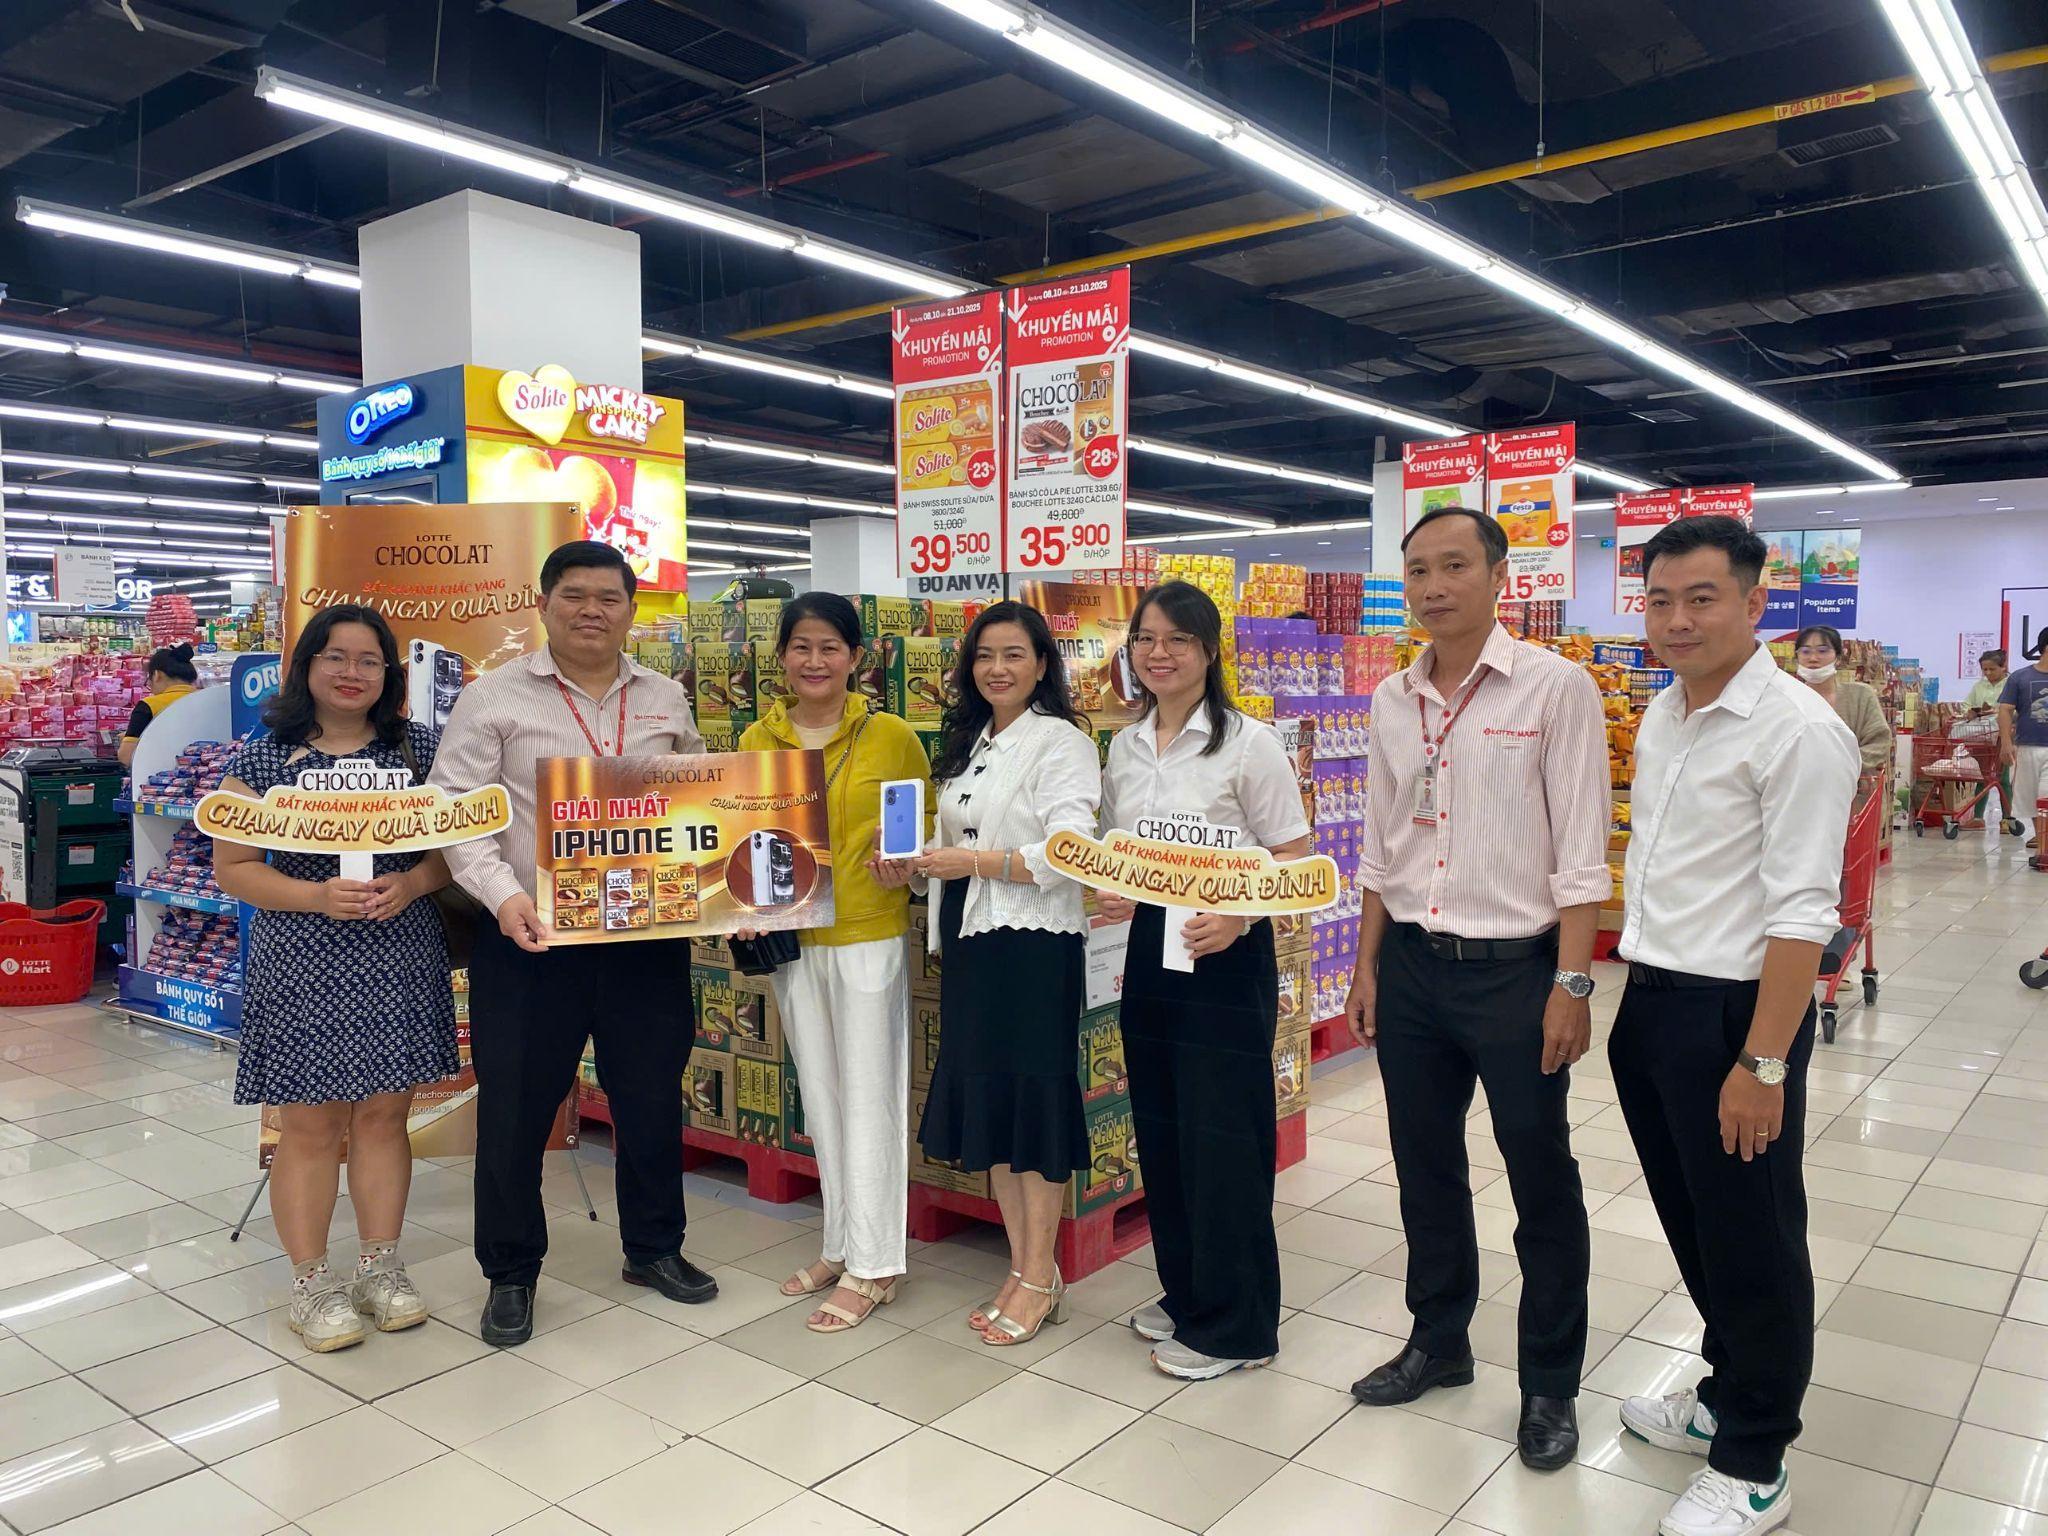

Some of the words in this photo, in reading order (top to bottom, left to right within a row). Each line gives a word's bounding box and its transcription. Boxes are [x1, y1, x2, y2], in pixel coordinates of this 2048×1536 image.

[1777, 106, 1788, 119] LP
[1791, 102, 1807, 116] GAS
[1043, 288, 1062, 299] 08.10
[1070, 280, 1108, 294] 21.10.2025
[923, 310, 940, 321] 08.10
[947, 303, 981, 317] 21.10.2025
[1018, 310, 1083, 338] KHUYẾN
[1086, 303, 1119, 325] MÃI
[901, 329, 961, 358] KHUYẾN
[963, 325, 991, 347] MÃI
[1041, 331, 1094, 348] PROMOTION
[923, 352, 969, 367] PROMOTION
[1052, 371, 1078, 381] LOTTE
[516, 385, 567, 411] Solite
[1021, 378, 1112, 408] CHOCOLAT
[350, 387, 412, 435] OREO
[575, 385, 666, 424] MICKEY
[593, 405, 649, 424] INSPIRED
[915, 408, 952, 432] Solite
[588, 414, 647, 443] CAKE
[1086, 448, 1118, 467] -28%
[1410, 457, 1454, 473] KHUYẾN
[1456, 454, 1476, 467] MÃI
[1495, 447, 1543, 463] KHUYẾN
[1545, 445, 1567, 458] MÃI
[323, 456, 350, 480] Bánh
[351, 455, 372, 478] quy
[915, 454, 952, 477] Solite
[968, 461, 995, 478] -23%
[1512, 460, 1550, 469] PROMOTION
[1426, 470, 1461, 479] PROMOTION
[1009, 490, 1028, 499] BÁNH
[1050, 487, 1059, 496] LA
[1060, 486, 1071, 495] PIE
[1072, 485, 1093, 494] LOTTE
[1044, 497, 1066, 506] LOTTE
[1067, 496, 1084, 505] 324G
[1102, 493, 1119, 504] LOẠI
[904, 501, 920, 509] BÁNH
[921, 499, 941, 507] SWISS
[941, 498, 961, 506] SOLITE
[1622, 504, 1657, 515] KHUYẾN
[1659, 503, 1675, 513] MÃI
[1690, 501, 1727, 511] KHUYẾN
[1729, 499, 1746, 509] MÃI
[416, 534, 452, 542] LOTTE
[1020, 523, 1110, 567] 35,900
[375, 544, 492, 566] CHOCOLAT
[911, 532, 990, 574] 39,500
[968, 556, 990, 565] Đ/HỘP
[1084, 548, 1110, 559] Đ/HỘP
[474, 578, 506, 593] VÀNG
[1501, 573, 1564, 599] 15,900
[379, 598, 443, 620] NGAY
[450, 593, 500, 622] QUÀ
[1089, 638, 1105, 659] 16
[301, 772, 408, 791] CHOCOLAT
[642, 768, 725, 784] CHOCOLAT
[276, 794, 301, 808] BẮT
[302, 796, 358, 812] KHOẢNH
[362, 798, 397, 812] KHẮC
[400, 795, 434, 808] VÀNG
[553, 796, 600, 821] GIẢI
[609, 791, 670, 819] NHẤT
[710, 798, 740, 810] CHẠM
[742, 802, 770, 811] NGAY
[207, 803, 288, 838] CHẠM
[293, 816, 369, 842] NGAY
[373, 811, 428, 844] QUÀ
[1172, 813, 1203, 823] LOTTE
[554, 828, 673, 858] IPHONE
[685, 825, 719, 851] 16
[1137, 820, 1238, 849] CHOCOLAT
[1112, 840, 1134, 854] BẮT
[1137, 845, 1187, 866] KHOẢNH
[1190, 854, 1223, 870] KHẮC
[1226, 856, 1260, 870] VÀNG
[1054, 840, 1122, 880] CHẠM
[1126, 864, 1196, 896] NGAY
[1199, 871, 1252, 904] QUÀ
[171, 896, 182, 904] MUA
[183, 897, 200, 908] NGAY
[156, 980, 182, 999] BÁNH
[184, 989, 203, 1006] QUY
[205, 989, 217, 1008] SỐ
[219, 997, 224, 1010] 1
[168, 1003, 186, 1021] THẾ
[1096, 1013, 1115, 1025] LOTTE
[1095, 1112, 1113, 1124] LOTTE
